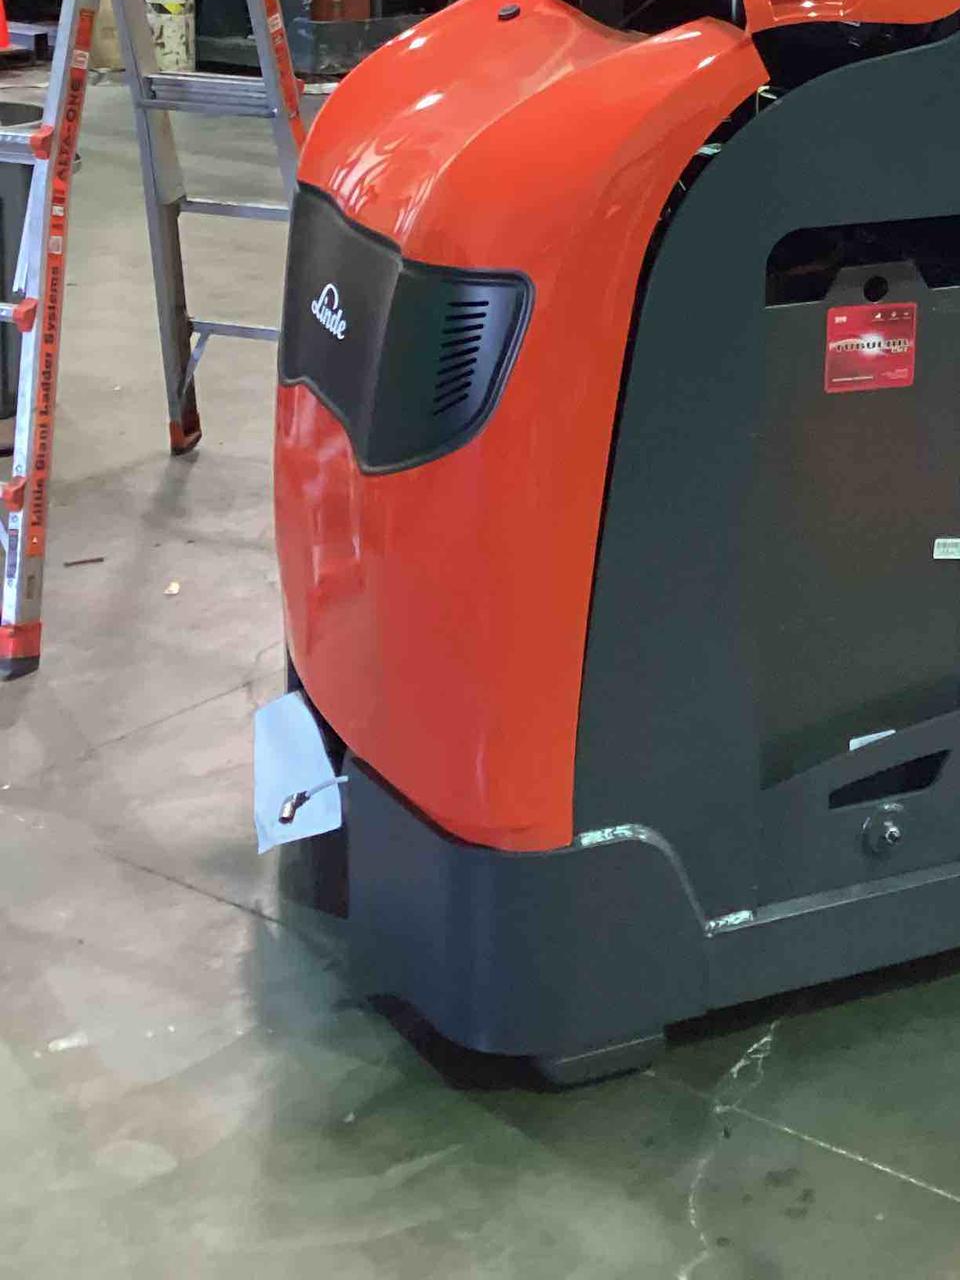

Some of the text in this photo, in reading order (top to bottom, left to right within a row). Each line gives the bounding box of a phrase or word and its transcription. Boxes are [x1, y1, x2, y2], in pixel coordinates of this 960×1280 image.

[57, 79, 84, 181] ALTA-ONE
[44, 266, 59, 345] Systems
[311, 283, 347, 340] Linde
[40, 352, 54, 416] Ladder
[35, 423, 48, 470] Giant
